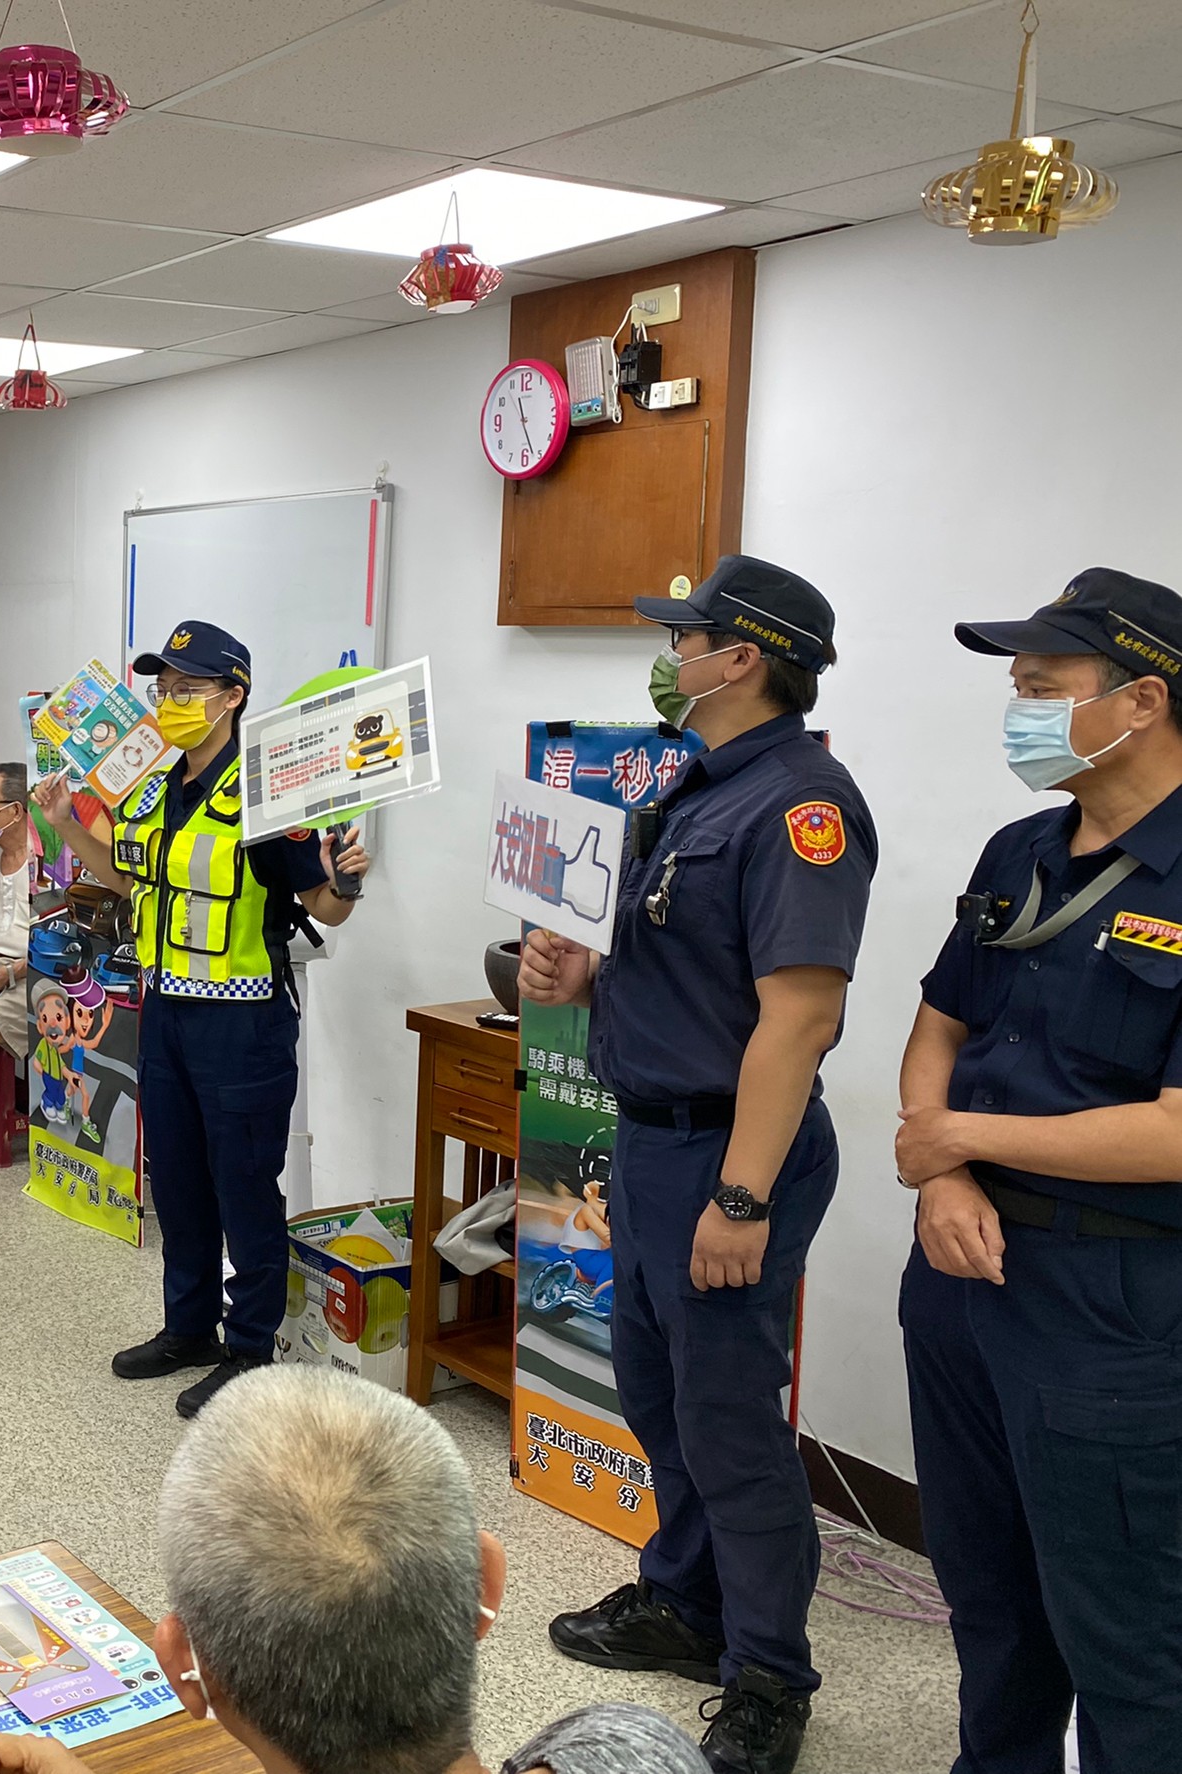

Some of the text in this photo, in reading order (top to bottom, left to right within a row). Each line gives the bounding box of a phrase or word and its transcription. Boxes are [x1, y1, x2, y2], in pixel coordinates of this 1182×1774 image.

[521, 372, 533, 392] 12
[498, 396, 506, 407] 10
[494, 413, 502, 433] 9
[550, 406, 557, 426] 3
[497, 439, 503, 450] 8
[537, 449, 543, 460] 5
[508, 452, 514, 463] 7
[521, 448, 529, 468] 6
[812, 850, 833, 860] 4333
[528, 1047, 600, 1084] 騎乘機
[526, 1411, 655, 1490] 臺北市政府警
